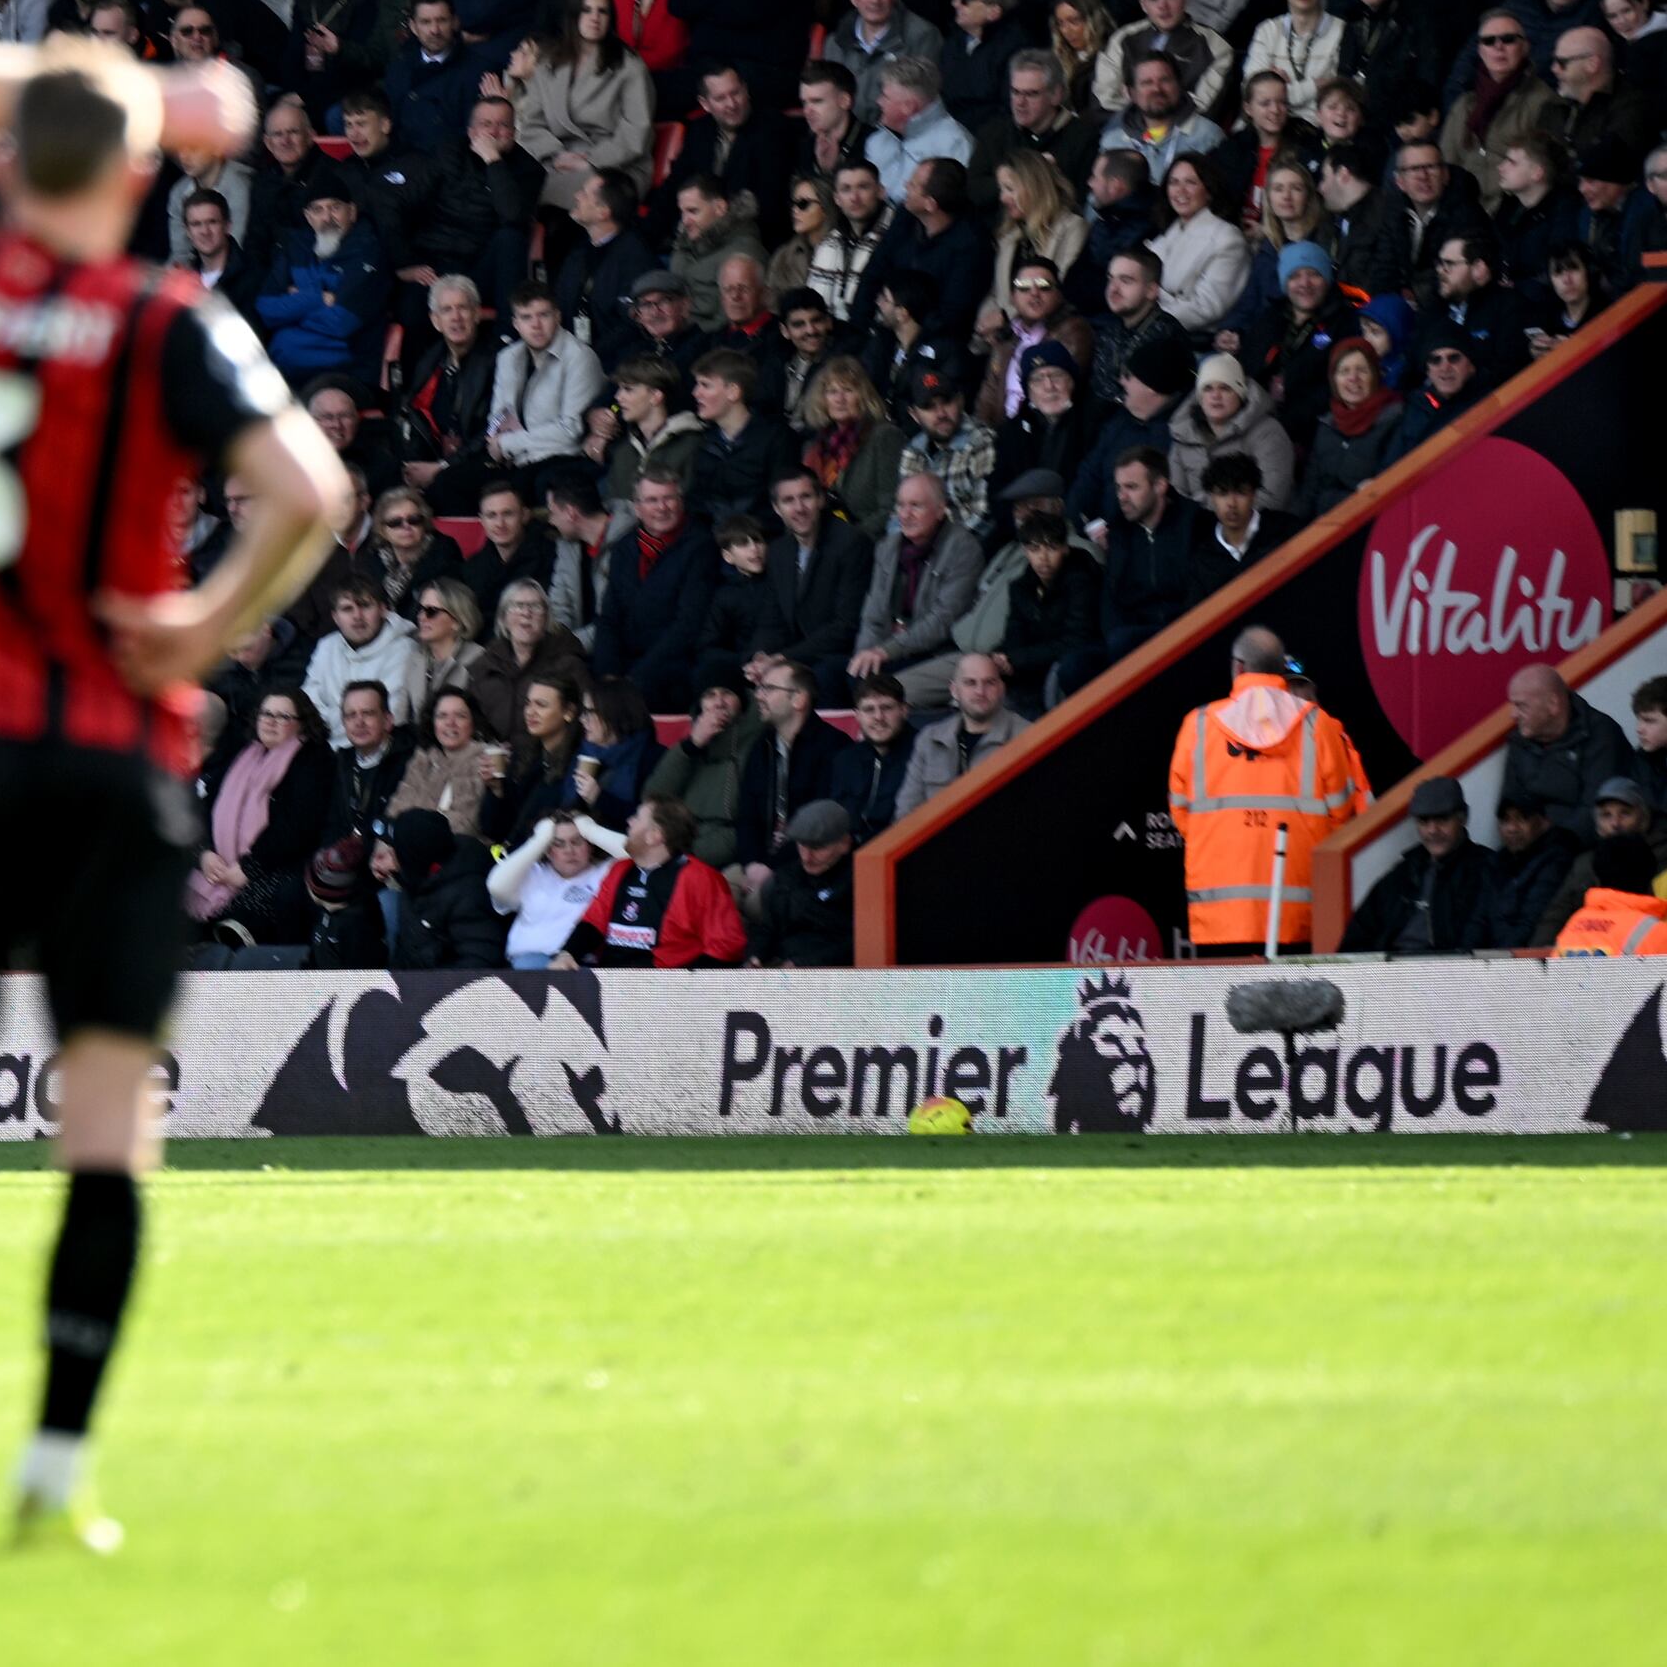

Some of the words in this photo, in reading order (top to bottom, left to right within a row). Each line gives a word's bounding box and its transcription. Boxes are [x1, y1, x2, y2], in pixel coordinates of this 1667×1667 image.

[1370, 523, 1605, 657] Vitality
[718, 1010, 1028, 1118] Premier
[1186, 1012, 1502, 1132] League
